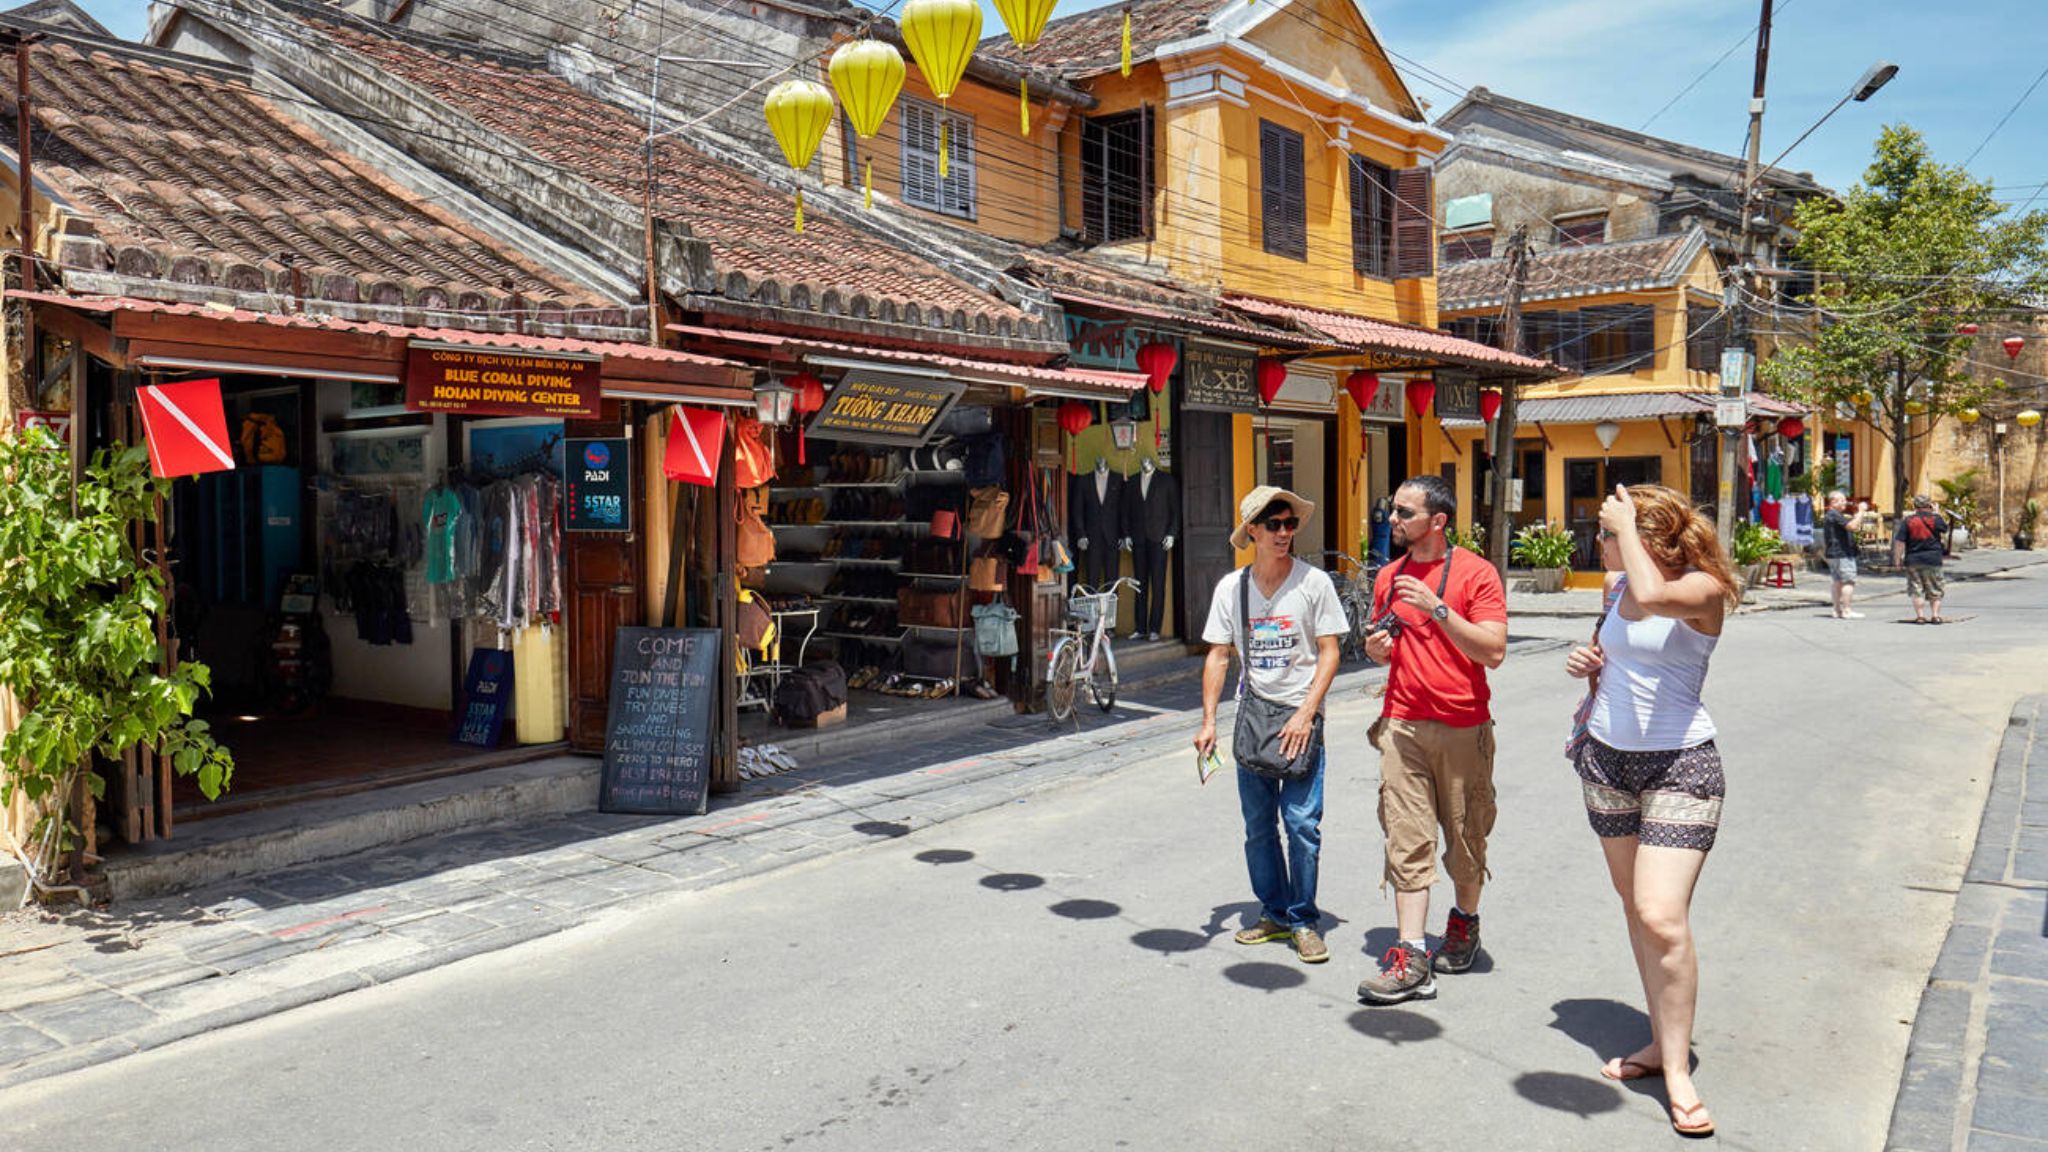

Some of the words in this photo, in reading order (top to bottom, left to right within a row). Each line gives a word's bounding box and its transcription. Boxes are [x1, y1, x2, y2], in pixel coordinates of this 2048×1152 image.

[464, 354, 475, 362] TY
[571, 362, 584, 371] AN
[445, 369, 478, 383] BLUE
[481, 371, 523, 386] CORAL
[527, 374, 572, 388] DIVING
[433, 385, 480, 400] HOIAN
[482, 388, 527, 403] DIVING
[531, 391, 580, 405] CENTER
[883, 402, 937, 425] KHANG
[584, 469, 610, 482] PADI
[637, 637, 697, 655] COME
[651, 658, 683, 671] AND
[620, 670, 652, 684] JOIN
[656, 671, 679, 686] THE
[627, 687, 650, 699] FUN
[653, 688, 688, 701] DIVES
[624, 701, 647, 713] TRY
[651, 701, 687, 714] DIVES
[645, 714, 668, 724] AND
[615, 724, 692, 738] SNORKELLING
[609, 739, 630, 751] ALL
[616, 753, 647, 764] ZERO
[649, 754, 662, 765] TO
